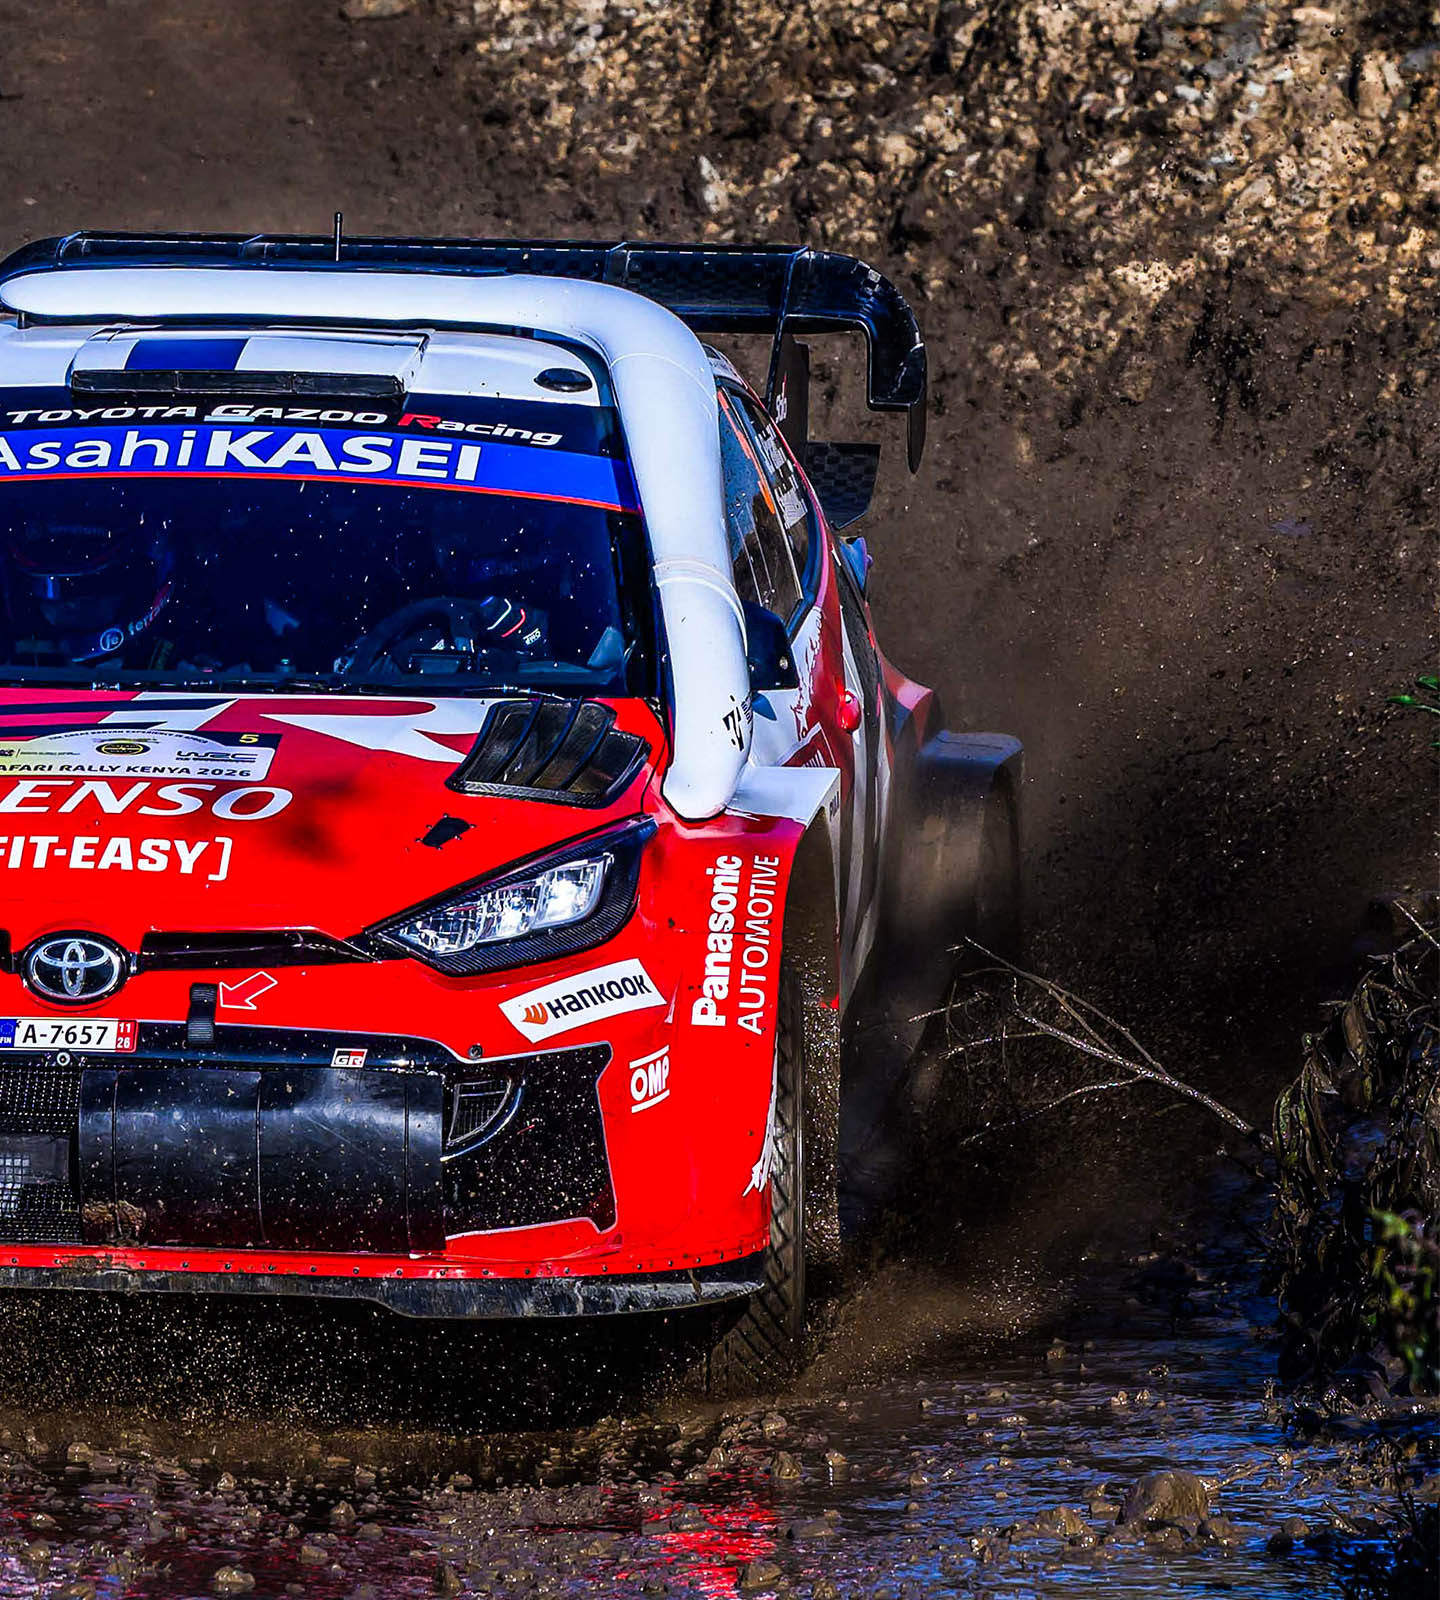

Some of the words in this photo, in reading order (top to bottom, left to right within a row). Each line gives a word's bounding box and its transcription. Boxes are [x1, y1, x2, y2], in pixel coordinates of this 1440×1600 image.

[5, 405, 198, 424] TOYOTA
[205, 404, 389, 424] GAZOO
[396, 412, 564, 447] Racing
[238, 733, 260, 744] 5
[176, 750, 258, 759] WRC
[59, 764, 121, 773] RALLY
[125, 765, 191, 775] KENYA
[196, 767, 252, 778] 2026
[691, 855, 743, 1027] Panasonic
[737, 854, 780, 1036] AUTOMOTIVE
[0, 1036, 12, 1044] FIN
[21, 1023, 109, 1046] A-7657
[118, 1023, 131, 1033] 11
[116, 1037, 131, 1048] 26
[334, 1054, 364, 1065] GR
[629, 1055, 670, 1102] OMP
